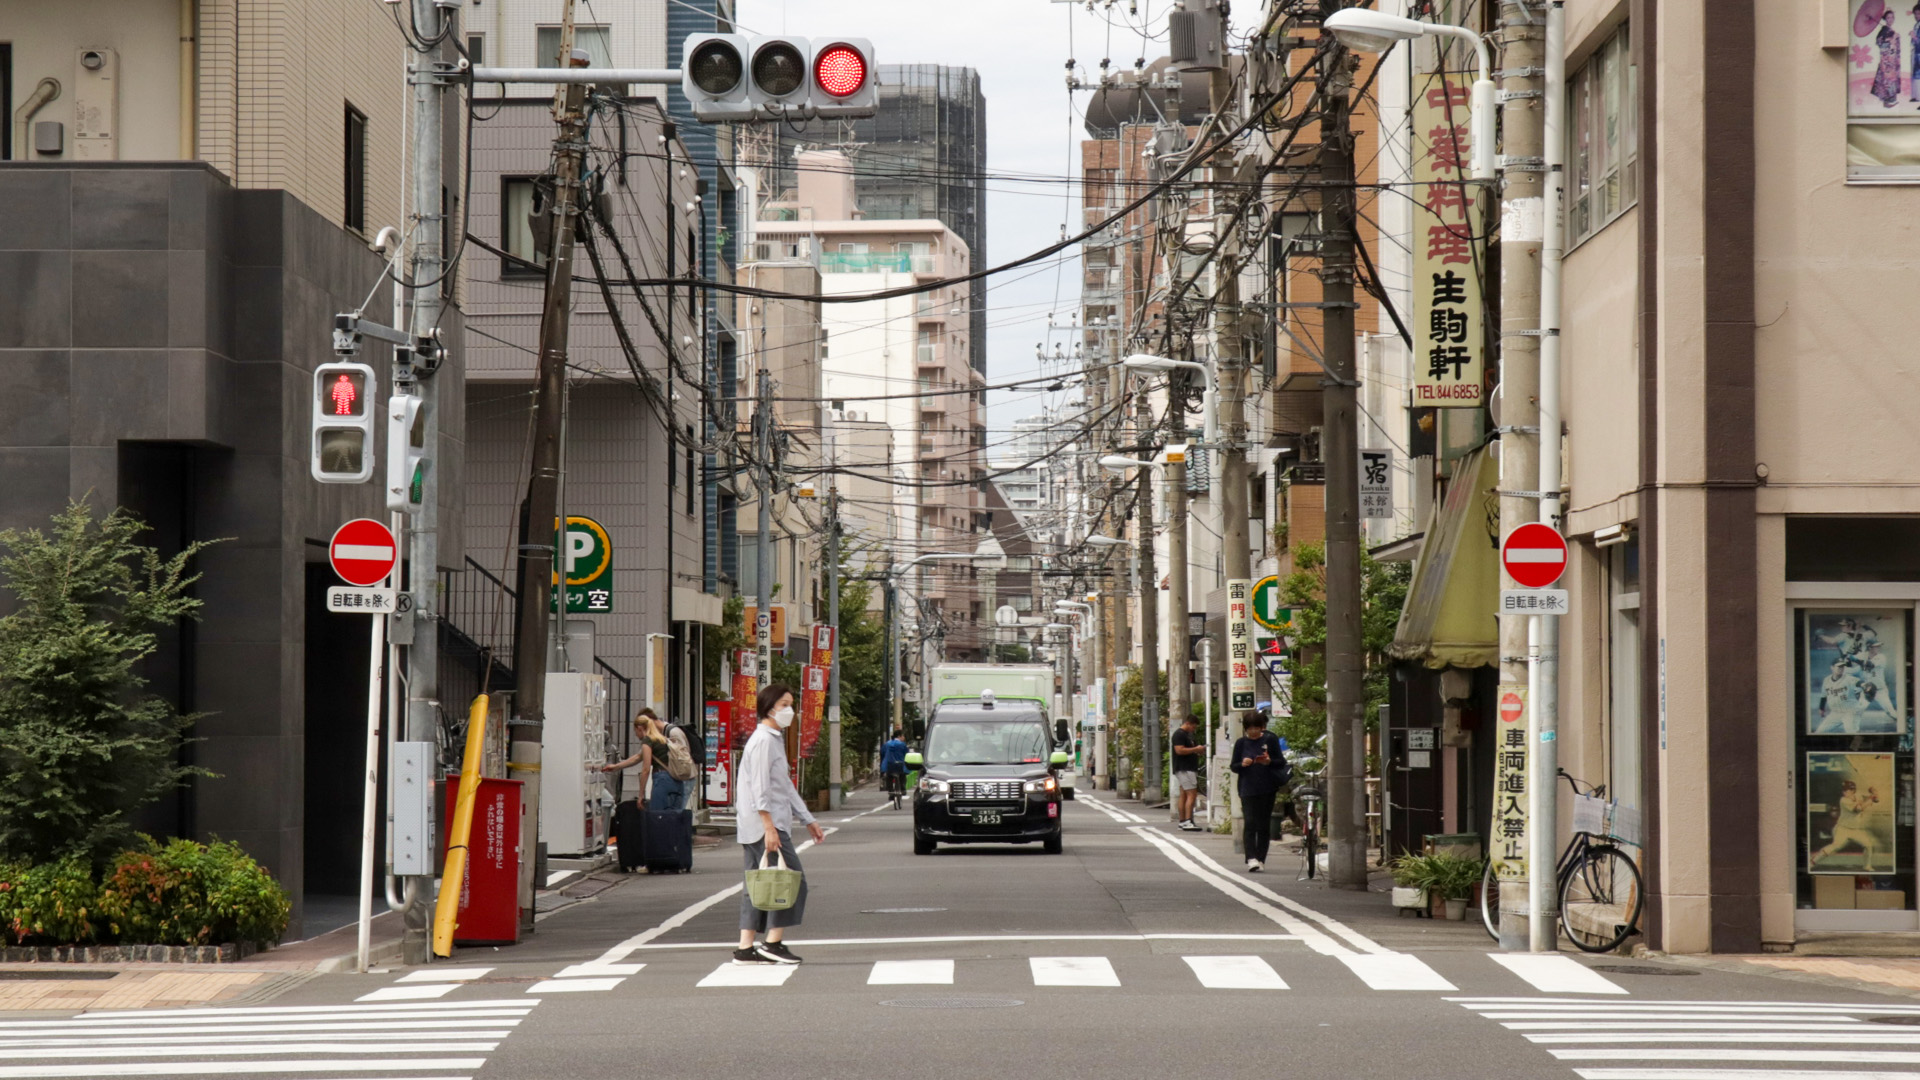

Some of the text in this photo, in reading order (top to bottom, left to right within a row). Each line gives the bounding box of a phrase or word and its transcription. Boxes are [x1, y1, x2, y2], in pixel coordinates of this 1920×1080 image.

[1426, 81, 1475, 265] 中華料理
[1427, 270, 1472, 381] 生駒軒
[333, 593, 390, 608] 自転車を除く
[588, 588, 609, 609] 空
[1230, 583, 1249, 679] 雷門學習塾
[1505, 595, 1565, 610] 自転車を除く
[758, 629, 768, 686] 中島歯科
[1503, 728, 1526, 862] 車両進入禁止
